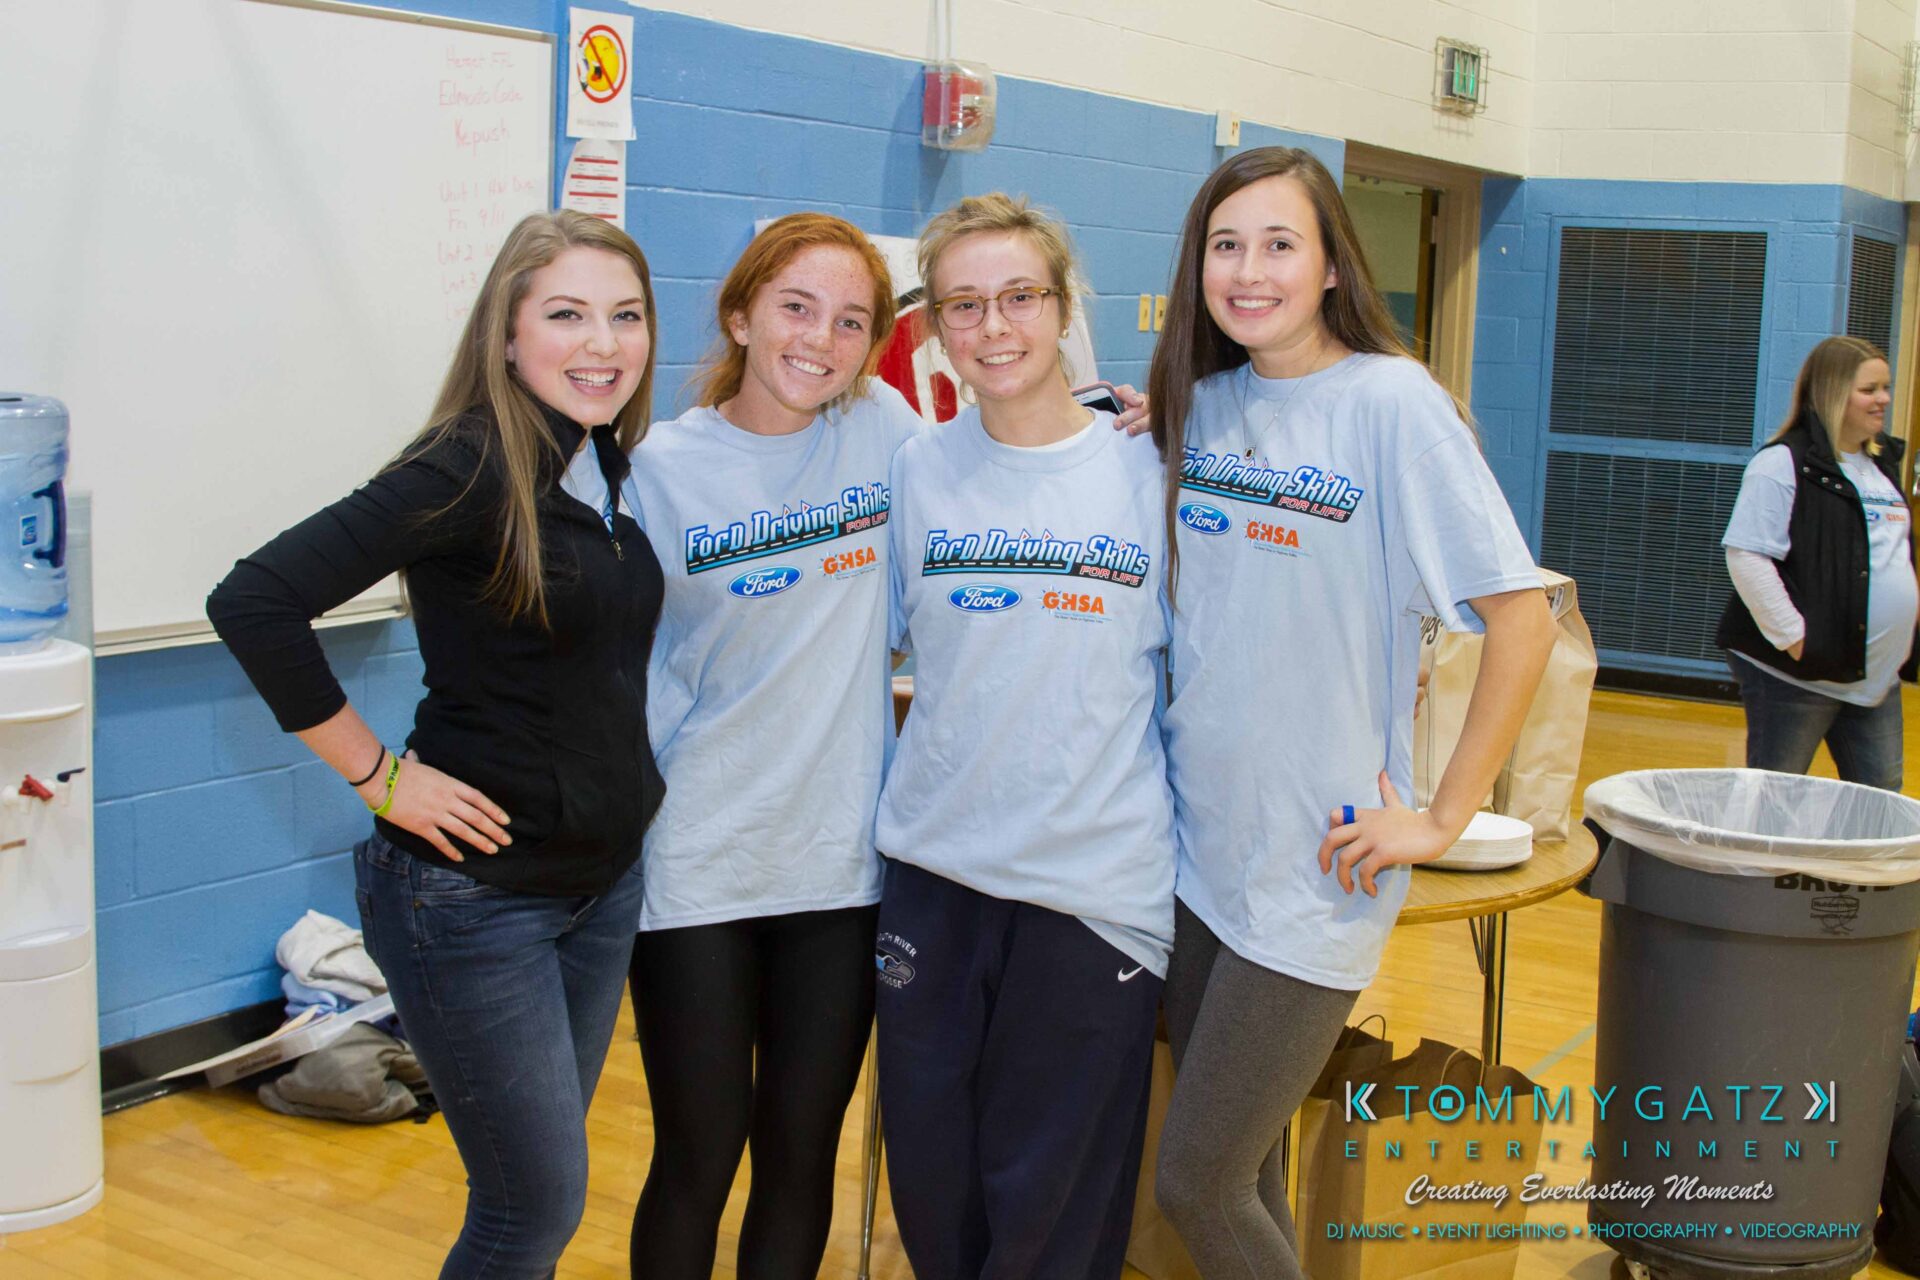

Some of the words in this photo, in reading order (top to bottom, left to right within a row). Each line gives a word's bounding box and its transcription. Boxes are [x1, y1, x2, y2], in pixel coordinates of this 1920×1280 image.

[1286, 465, 1364, 511] Skills
[751, 500, 839, 547] Driving
[841, 481, 890, 523] Skills
[1186, 505, 1221, 531] Ford
[1278, 496, 1308, 512] FOR
[1310, 505, 1347, 521] LIFE
[846, 519, 870, 533] FOR
[1247, 521, 1300, 548] GHSA
[823, 546, 877, 574] GHSA
[981, 528, 1083, 568] Driving
[1083, 535, 1150, 575] Skills
[743, 570, 788, 595] Ford
[1079, 565, 1110, 579] FOR
[1112, 571, 1140, 586] LIFE
[960, 586, 1007, 609] Ford
[1042, 591, 1105, 615] GHSA
[893, 935, 917, 957] RIVER
